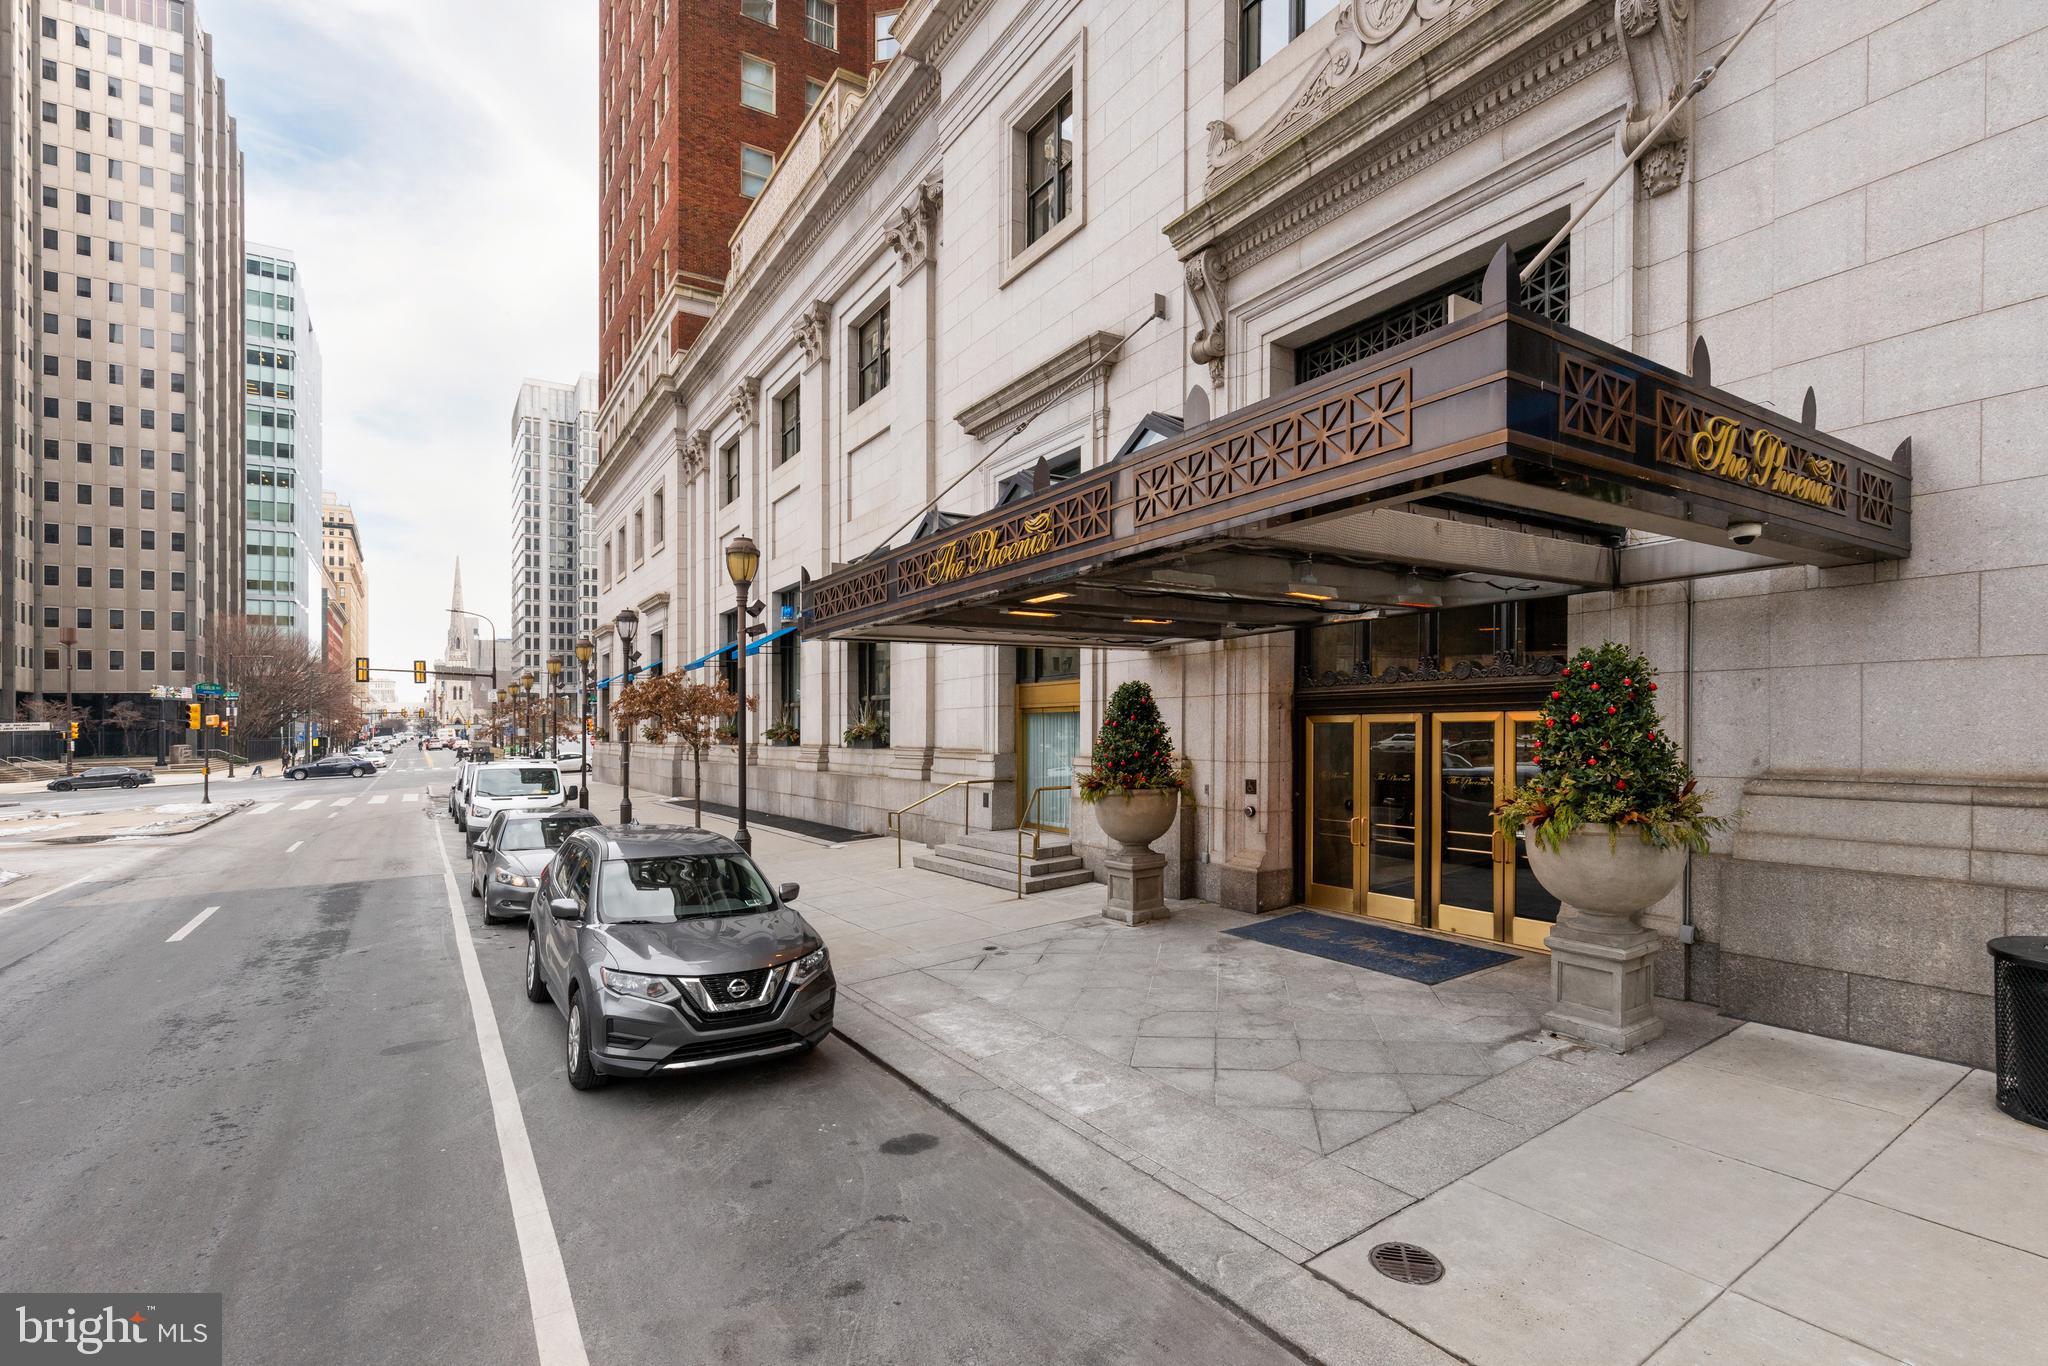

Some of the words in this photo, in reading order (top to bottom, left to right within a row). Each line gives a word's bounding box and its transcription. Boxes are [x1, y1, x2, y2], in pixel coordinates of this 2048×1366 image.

[1690, 416, 1749, 481] The
[1752, 429, 1833, 507] Phoenix
[926, 541, 964, 587] The
[968, 529, 1055, 574] Phoenix
